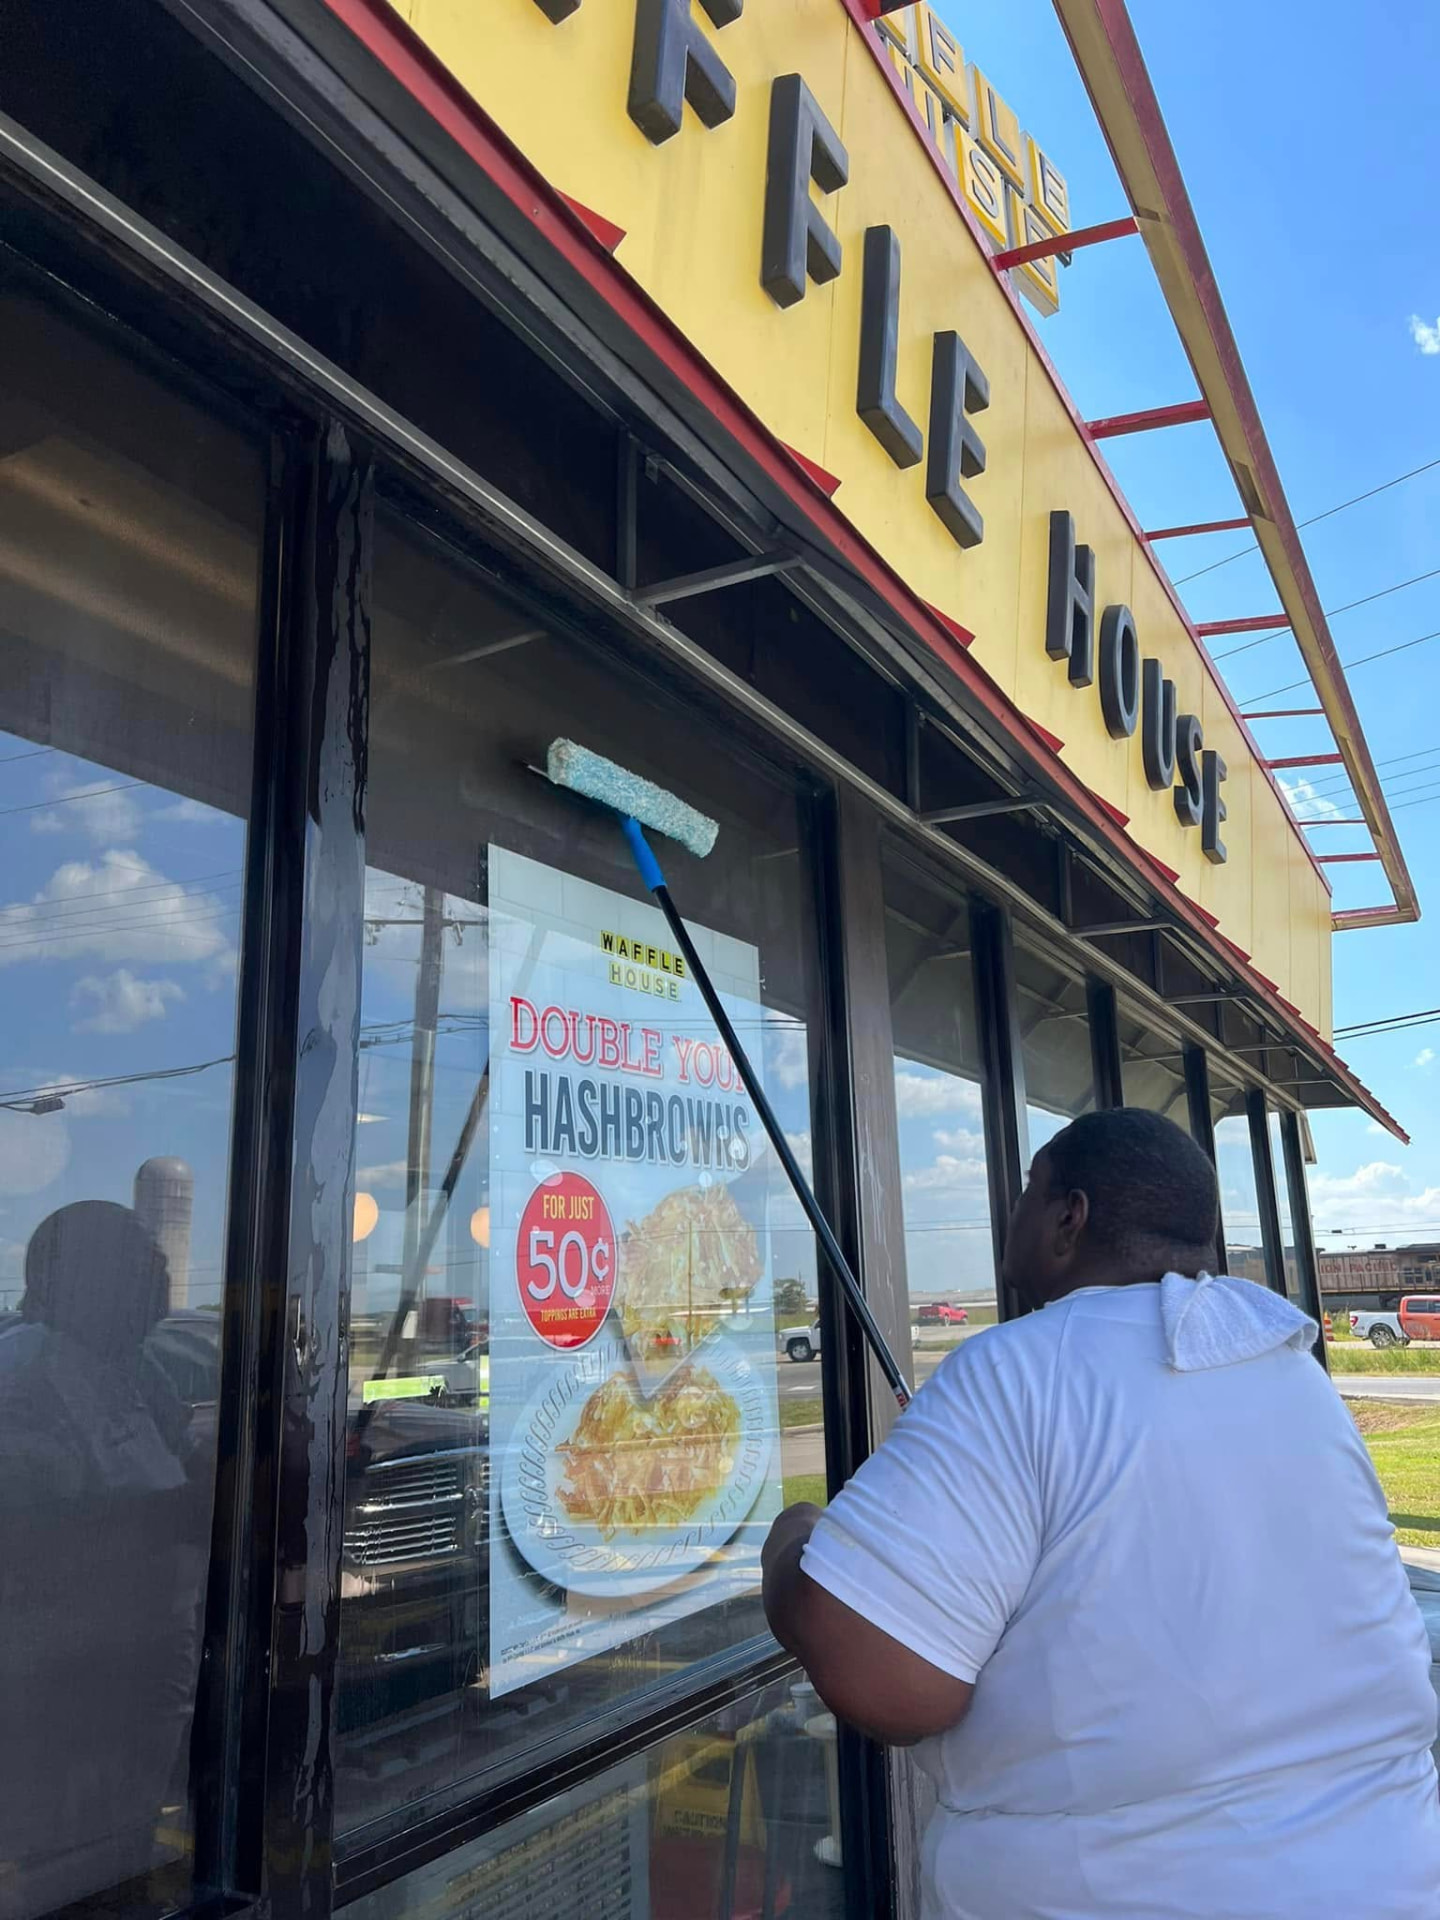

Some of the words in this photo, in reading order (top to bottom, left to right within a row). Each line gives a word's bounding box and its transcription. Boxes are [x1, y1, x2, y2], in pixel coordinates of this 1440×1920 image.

[533, 0, 990, 549] FFLE
[1045, 510, 1227, 865] HOUSE
[602, 932, 684, 976] WAFFLE
[611, 963, 677, 999] HOUSE
[510, 996, 662, 1076] DOUBLE
[525, 1070, 749, 1170] HASHBROWNS
[543, 1194, 566, 1219] FOR
[568, 1197, 595, 1220] JUST
[527, 1230, 610, 1300] 50¢
[590, 1284, 611, 1297] MORE
[568, 1307, 580, 1320] ARE
